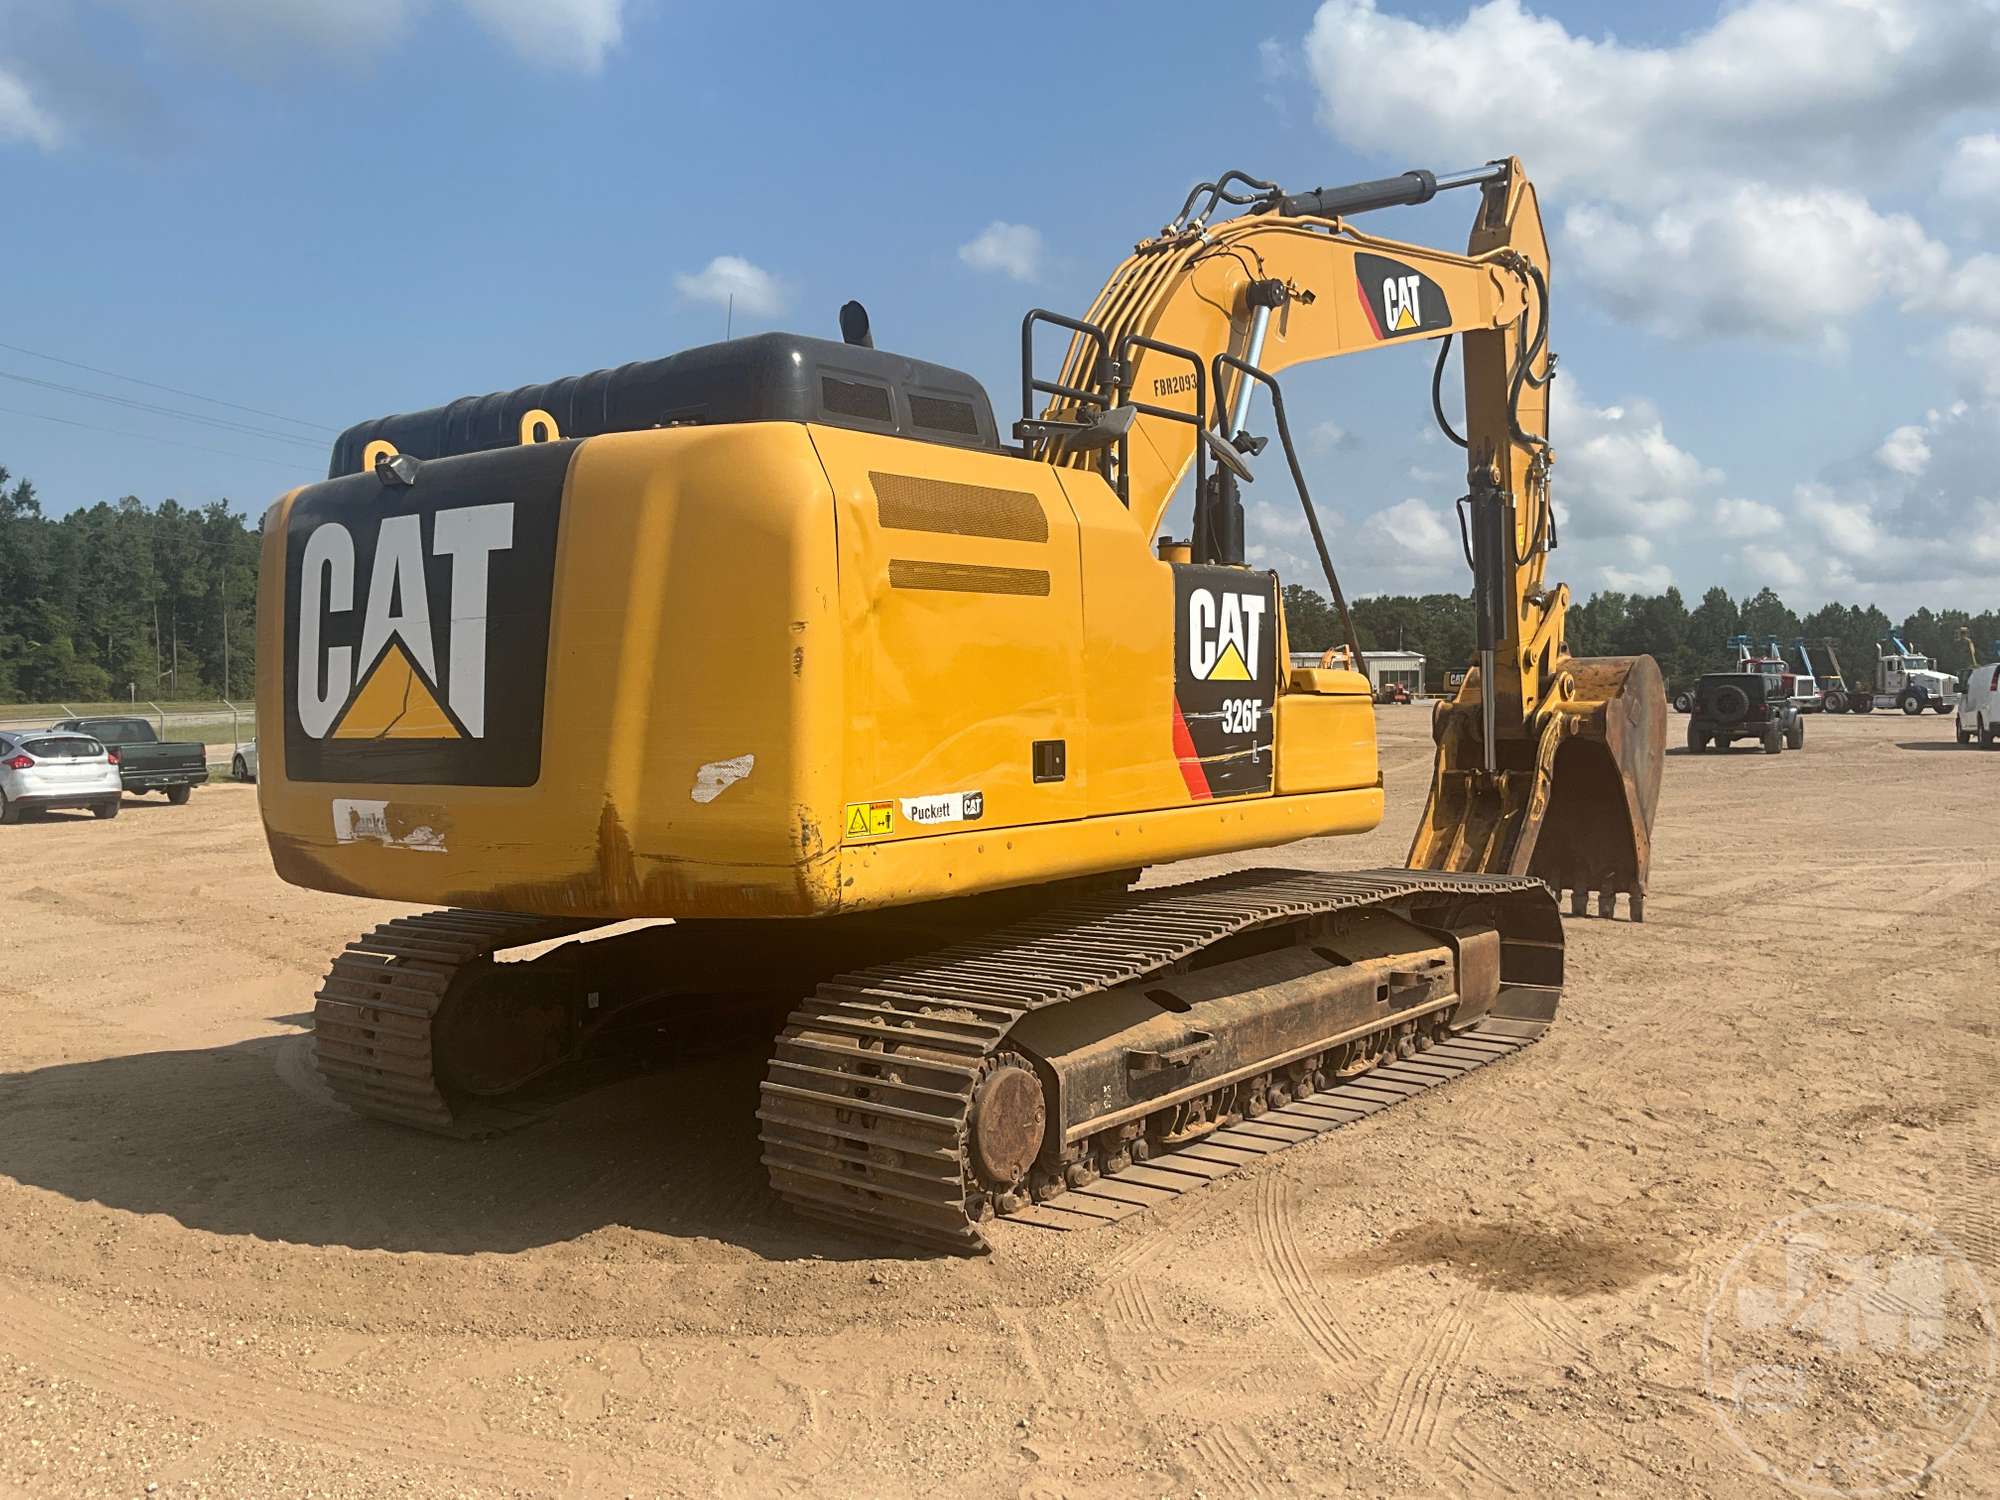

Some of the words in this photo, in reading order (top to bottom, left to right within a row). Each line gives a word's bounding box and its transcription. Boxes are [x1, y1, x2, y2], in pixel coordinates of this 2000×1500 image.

[1383, 275, 1421, 331] CAT
[1153, 373, 1197, 397] FBR2093
[298, 502, 514, 739] CAT
[1189, 588, 1265, 680] CAT
[1222, 699, 1262, 733] 326F
[1252, 740, 1260, 763] L
[911, 802, 950, 820] Puckett
[963, 799, 982, 815] CAT
